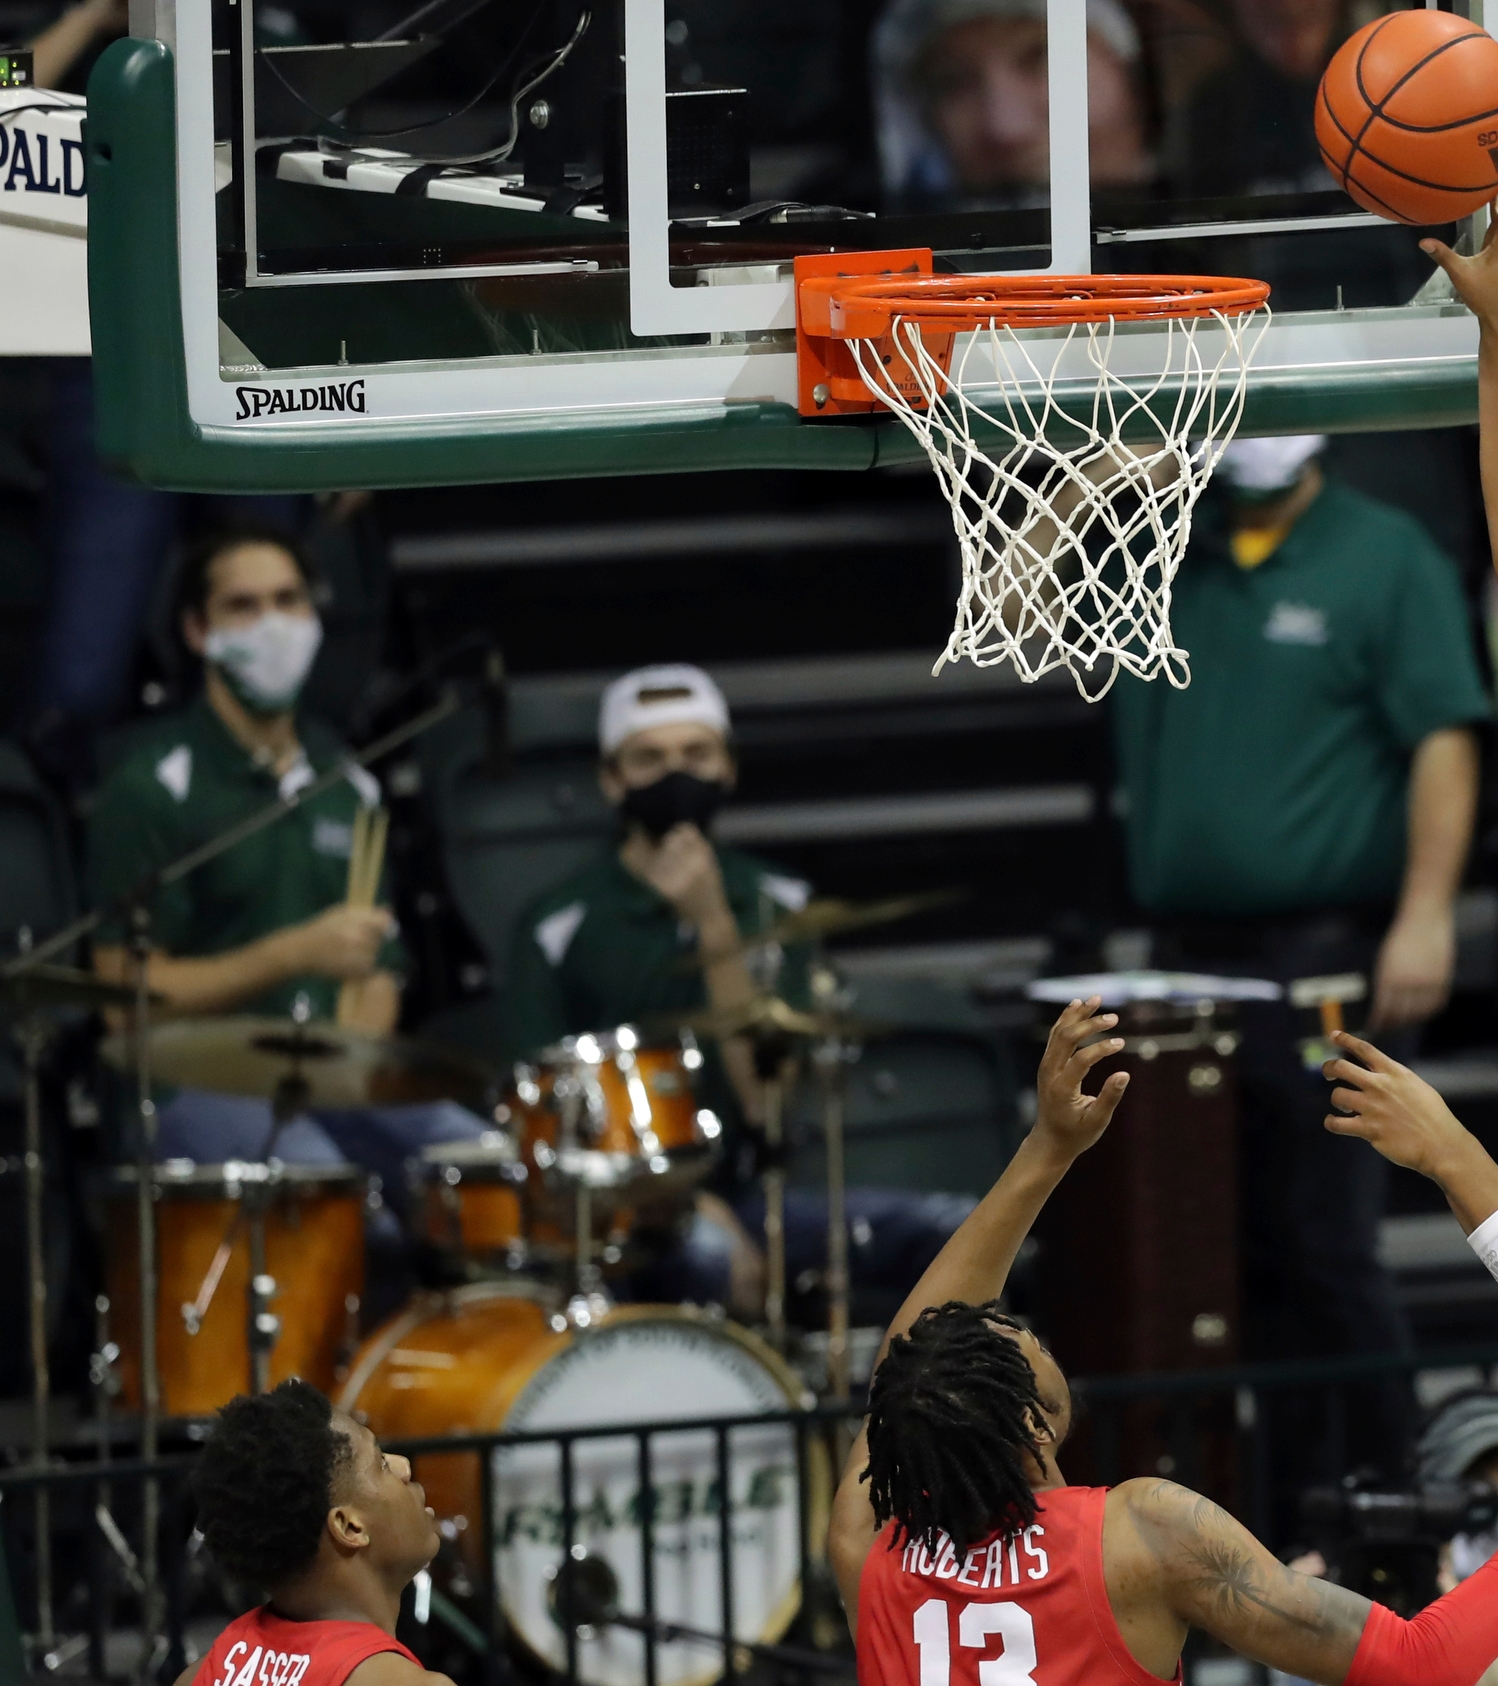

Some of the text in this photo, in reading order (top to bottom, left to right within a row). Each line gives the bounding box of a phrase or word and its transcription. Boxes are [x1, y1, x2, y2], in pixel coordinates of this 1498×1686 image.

[236, 379, 366, 421] SPALDING
[902, 1524, 1049, 1588] ROBERTS
[214, 1640, 311, 1686] SASSER
[913, 1598, 1038, 1686] 13
